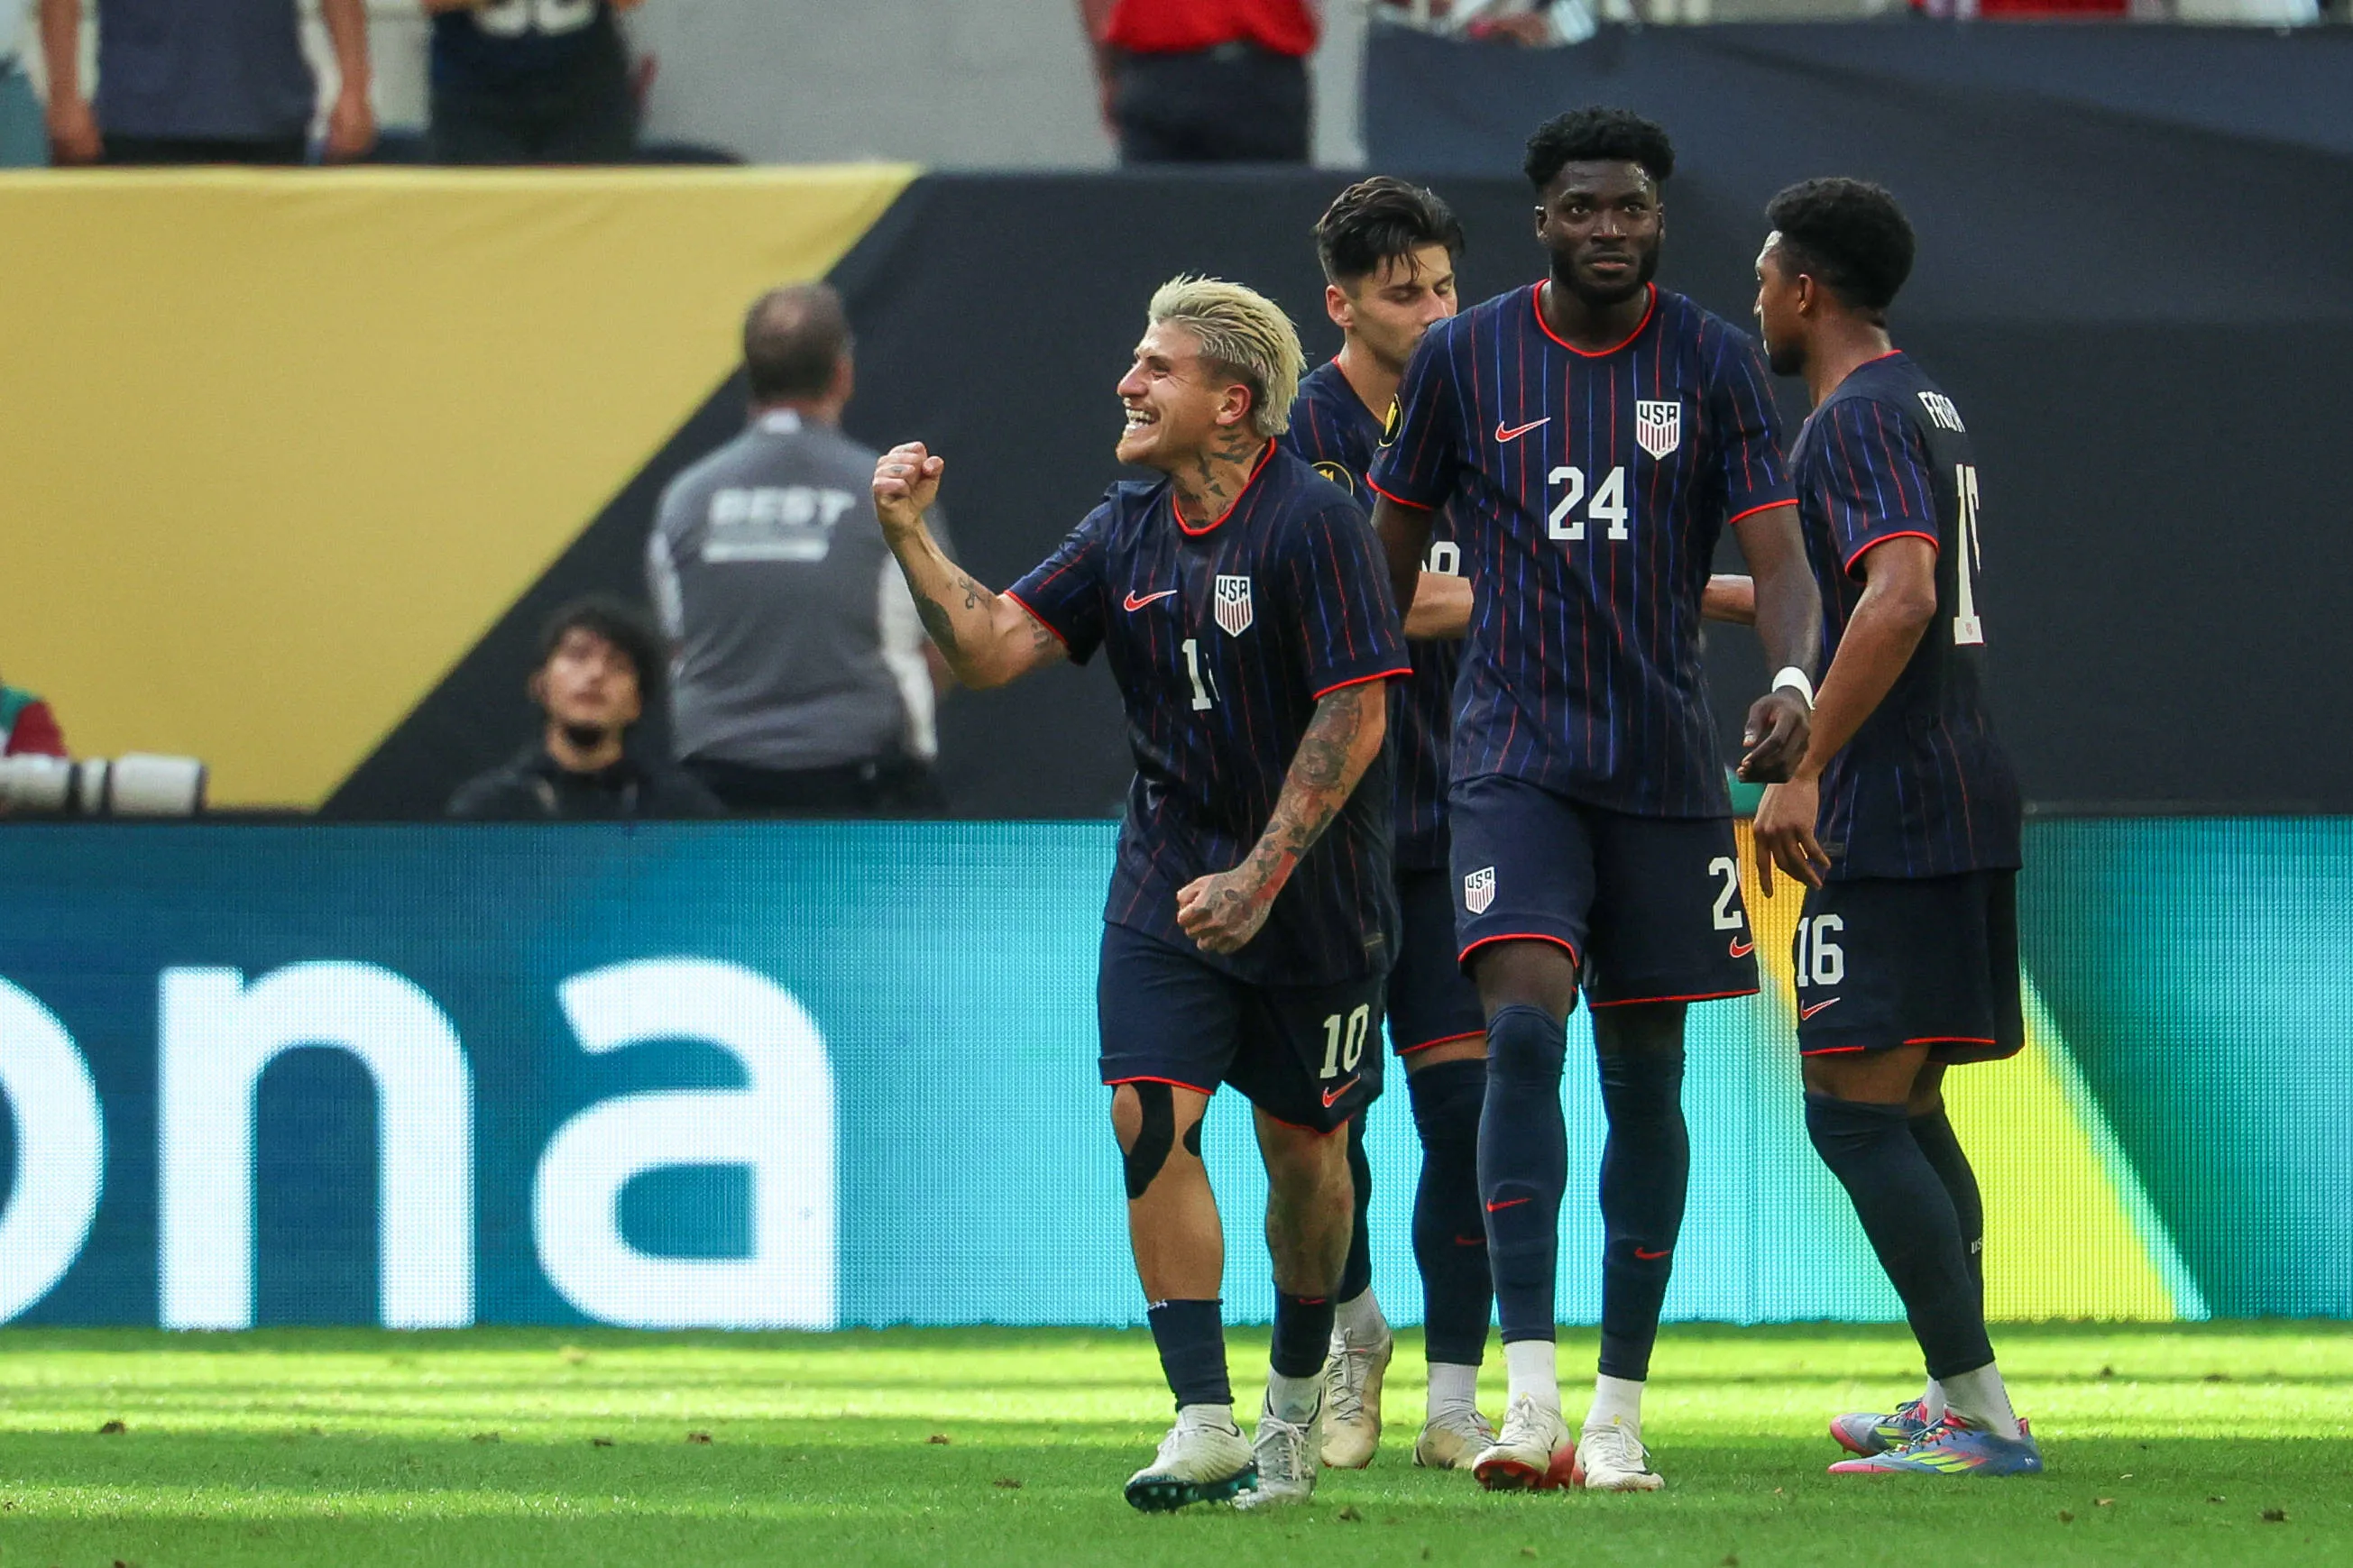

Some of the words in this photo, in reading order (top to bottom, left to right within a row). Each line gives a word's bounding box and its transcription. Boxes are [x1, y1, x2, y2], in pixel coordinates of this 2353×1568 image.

[1640, 403, 1677, 426] USA
[711, 487, 856, 526] BEST
[1548, 466, 1629, 540] 24
[1218, 578, 1248, 601] USA
[1181, 639, 1220, 711] 1
[1466, 869, 1492, 889] USA
[1708, 857, 1743, 931] 2
[1797, 913, 1844, 987] 16
[1319, 1003, 1369, 1078] 10
